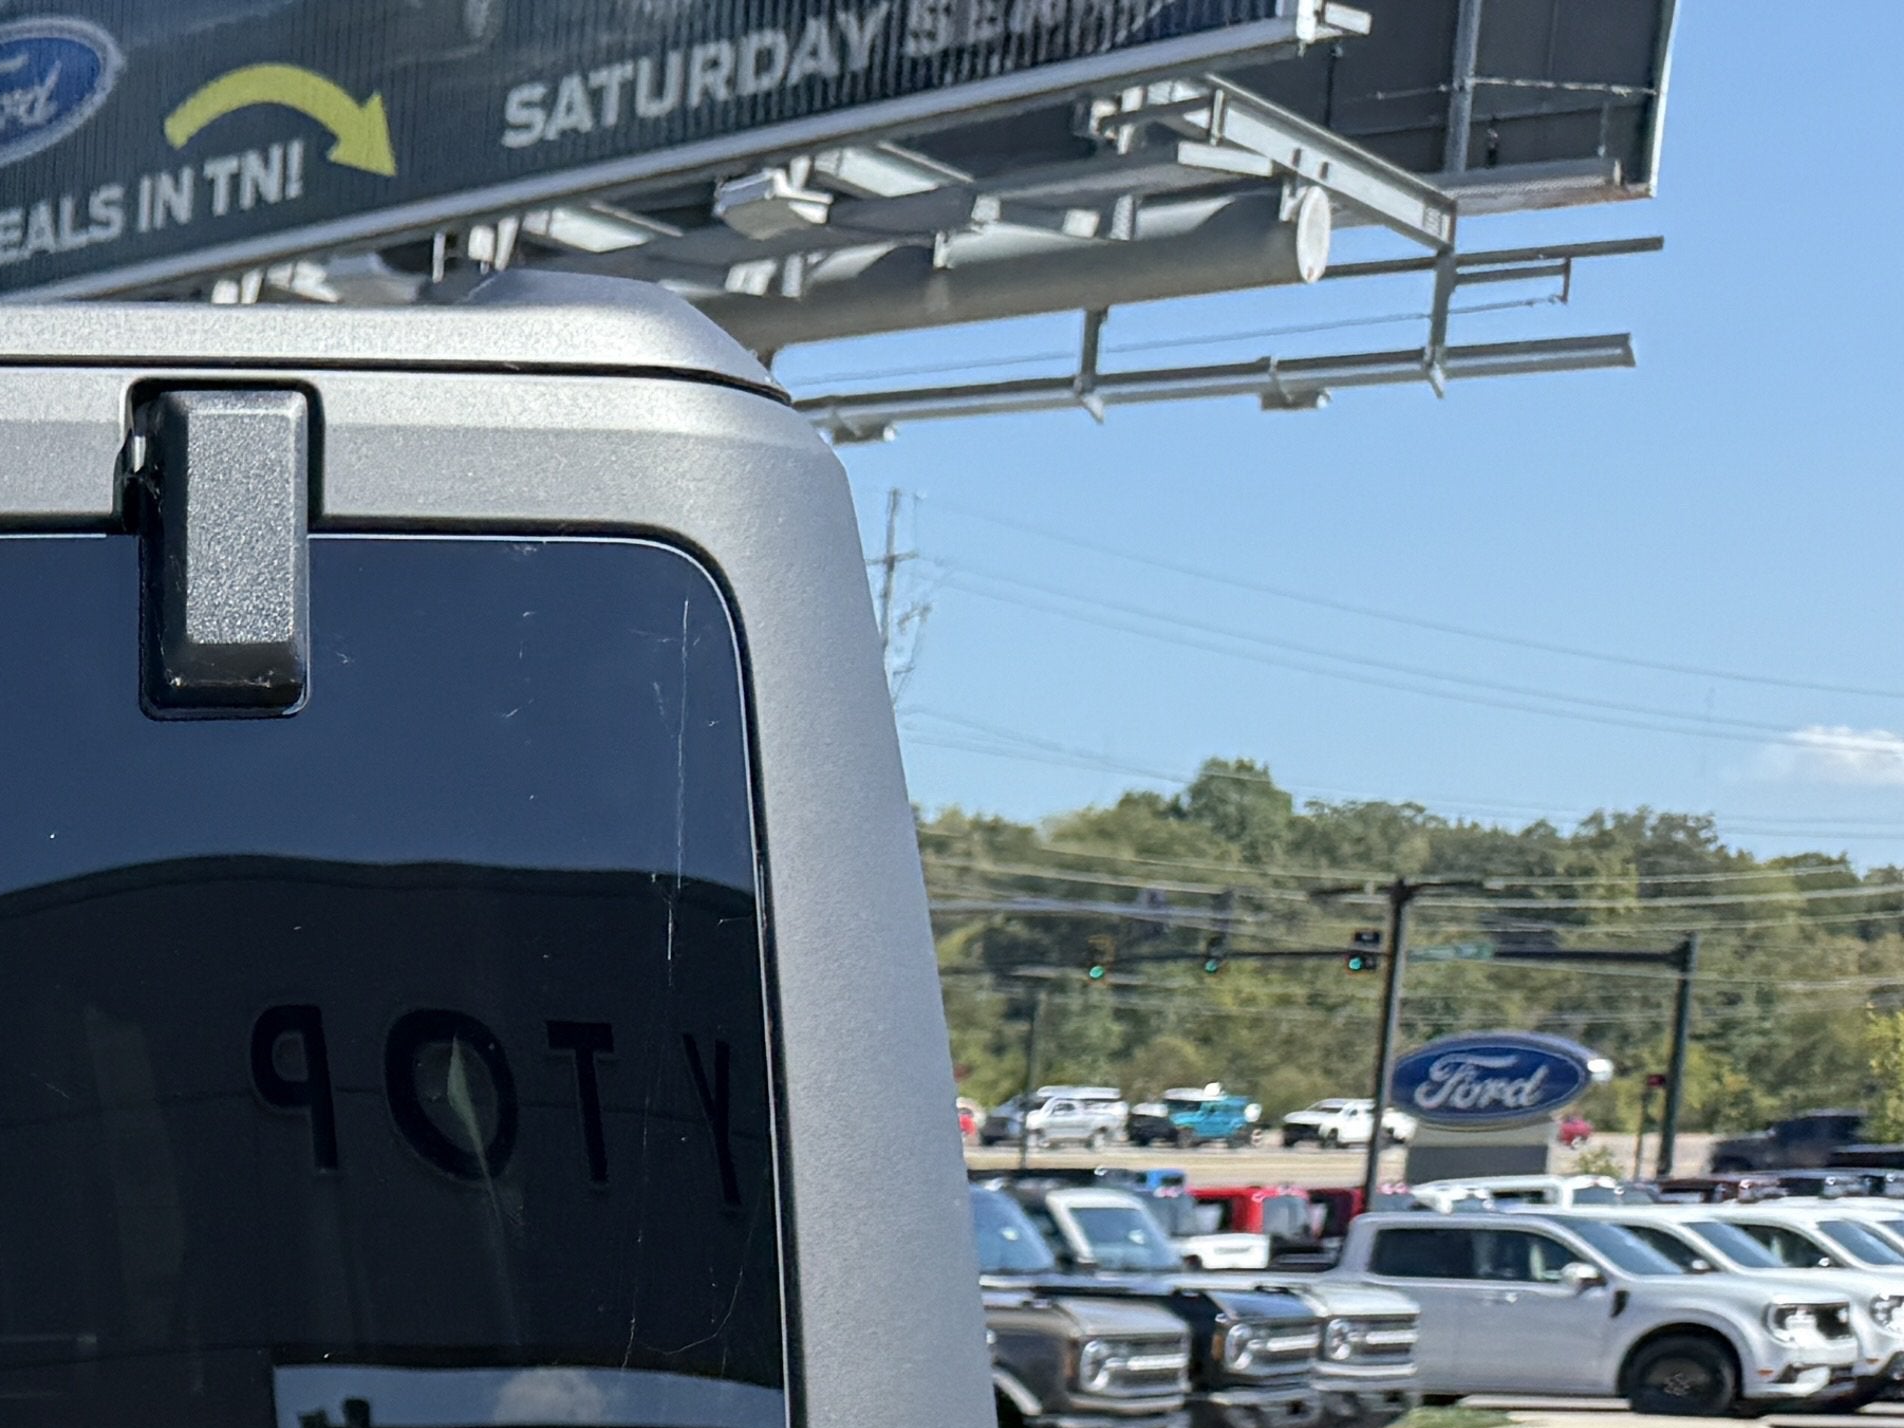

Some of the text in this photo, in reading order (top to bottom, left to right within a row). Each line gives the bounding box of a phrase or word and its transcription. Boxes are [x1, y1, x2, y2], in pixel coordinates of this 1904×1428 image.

[502, 5, 892, 148] SATURDAY
[138, 164, 192, 233] IN
[203, 140, 306, 217] TN!
[1413, 1054, 1551, 1113] Ford
